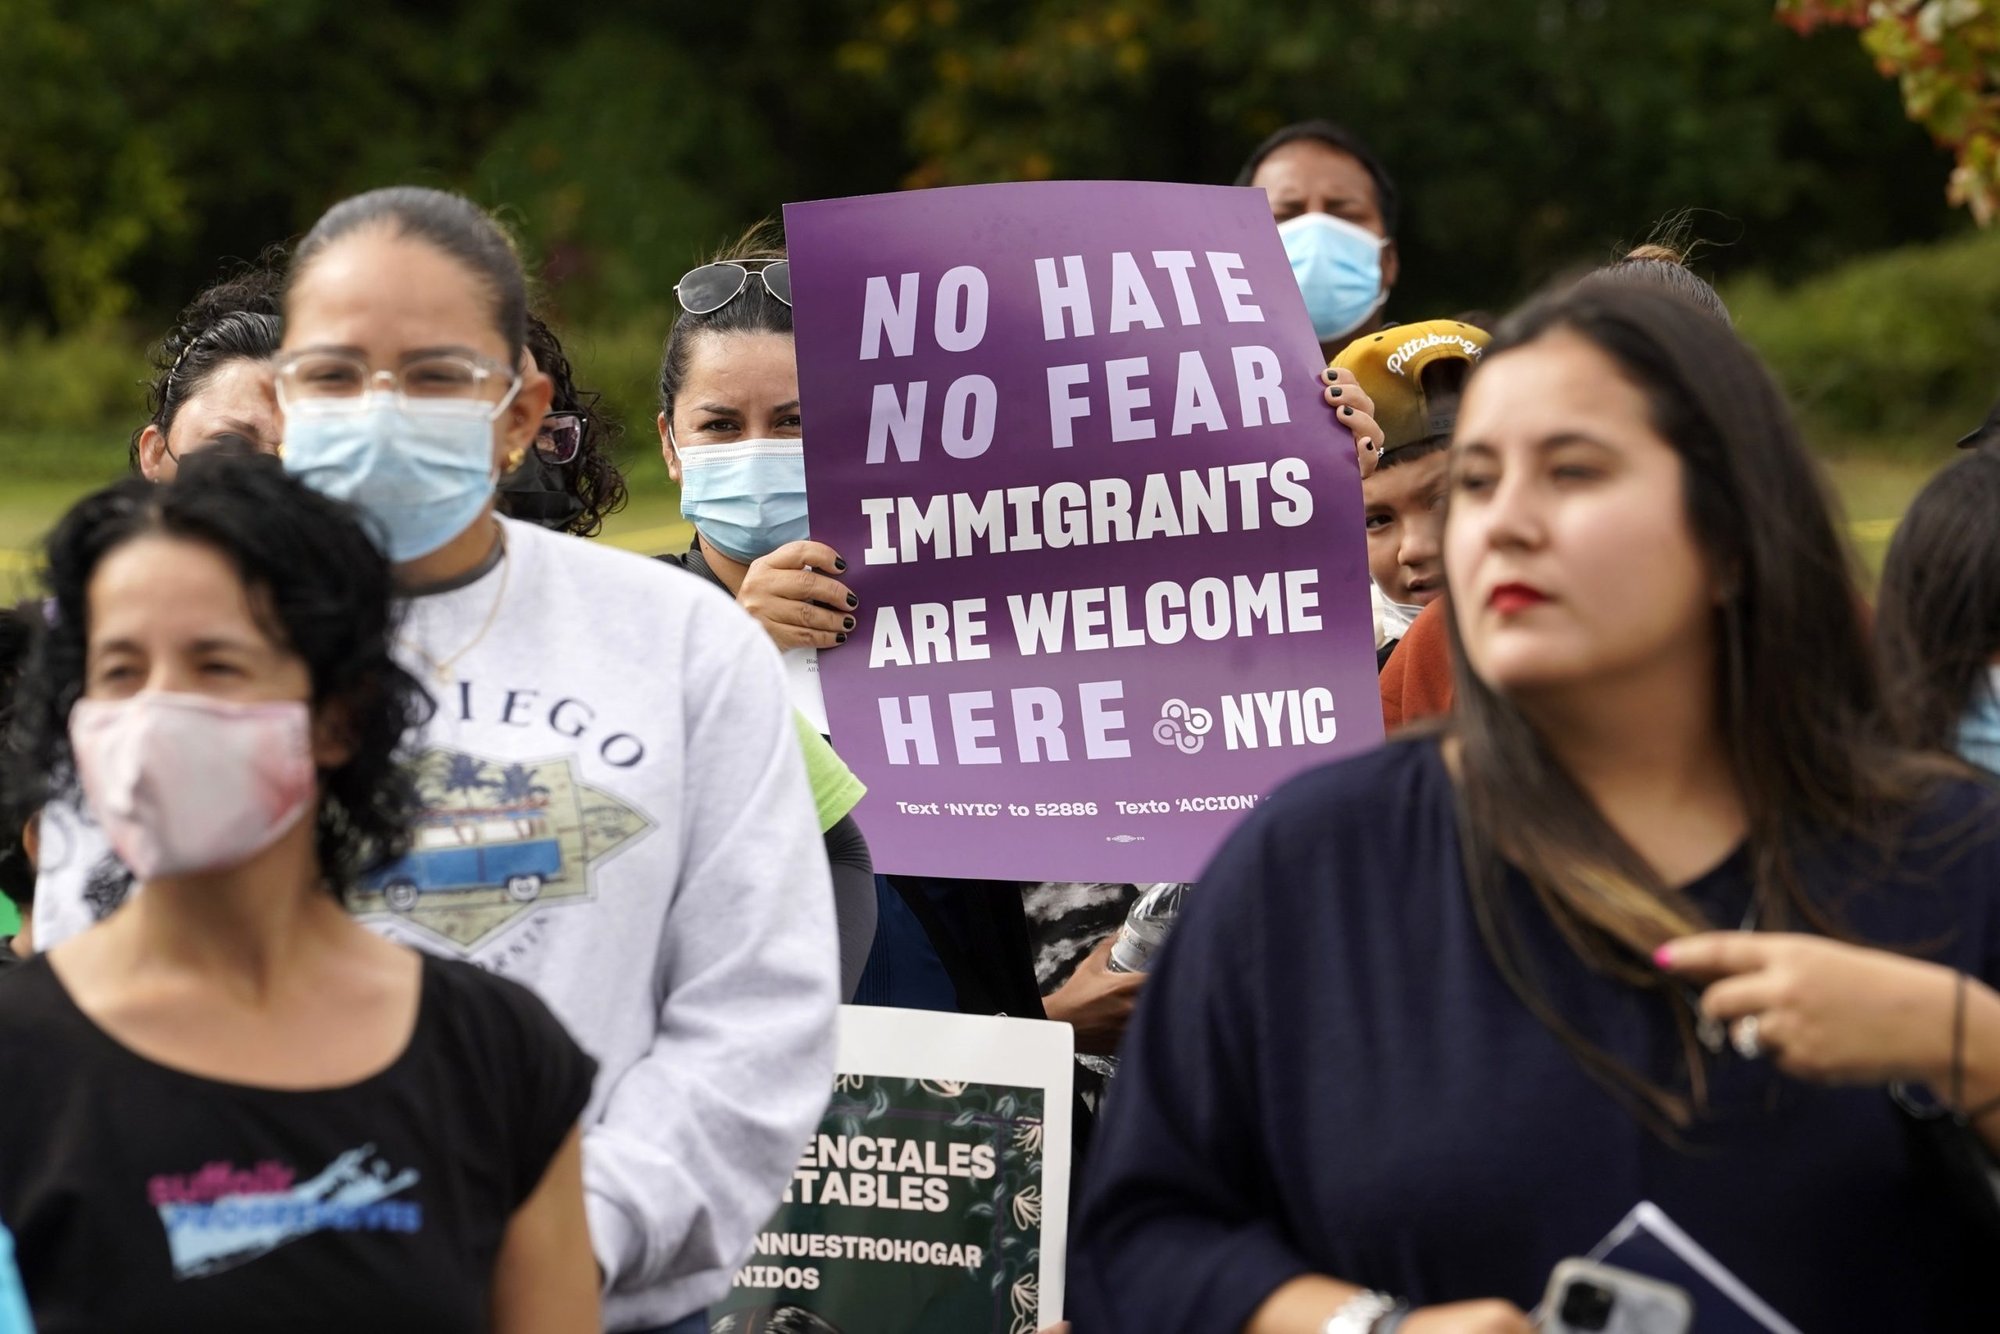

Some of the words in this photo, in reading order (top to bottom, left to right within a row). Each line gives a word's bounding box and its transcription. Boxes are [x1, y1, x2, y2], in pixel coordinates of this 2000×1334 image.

[860, 265, 989, 361] NO
[1034, 250, 1265, 340] HATE
[866, 374, 998, 465] NO
[1046, 345, 1291, 449] FEAR
[861, 457, 1314, 566] IMMIGRANTS
[868, 597, 991, 668] ARE
[1007, 568, 1323, 656] WELCOME
[877, 680, 1132, 766] HERE
[1222, 686, 1337, 751] NYIC
[896, 801, 940, 815] Text
[1008, 803, 1030, 817] to
[1035, 802, 1099, 817] 52886
[1115, 800, 1171, 815] Texto
